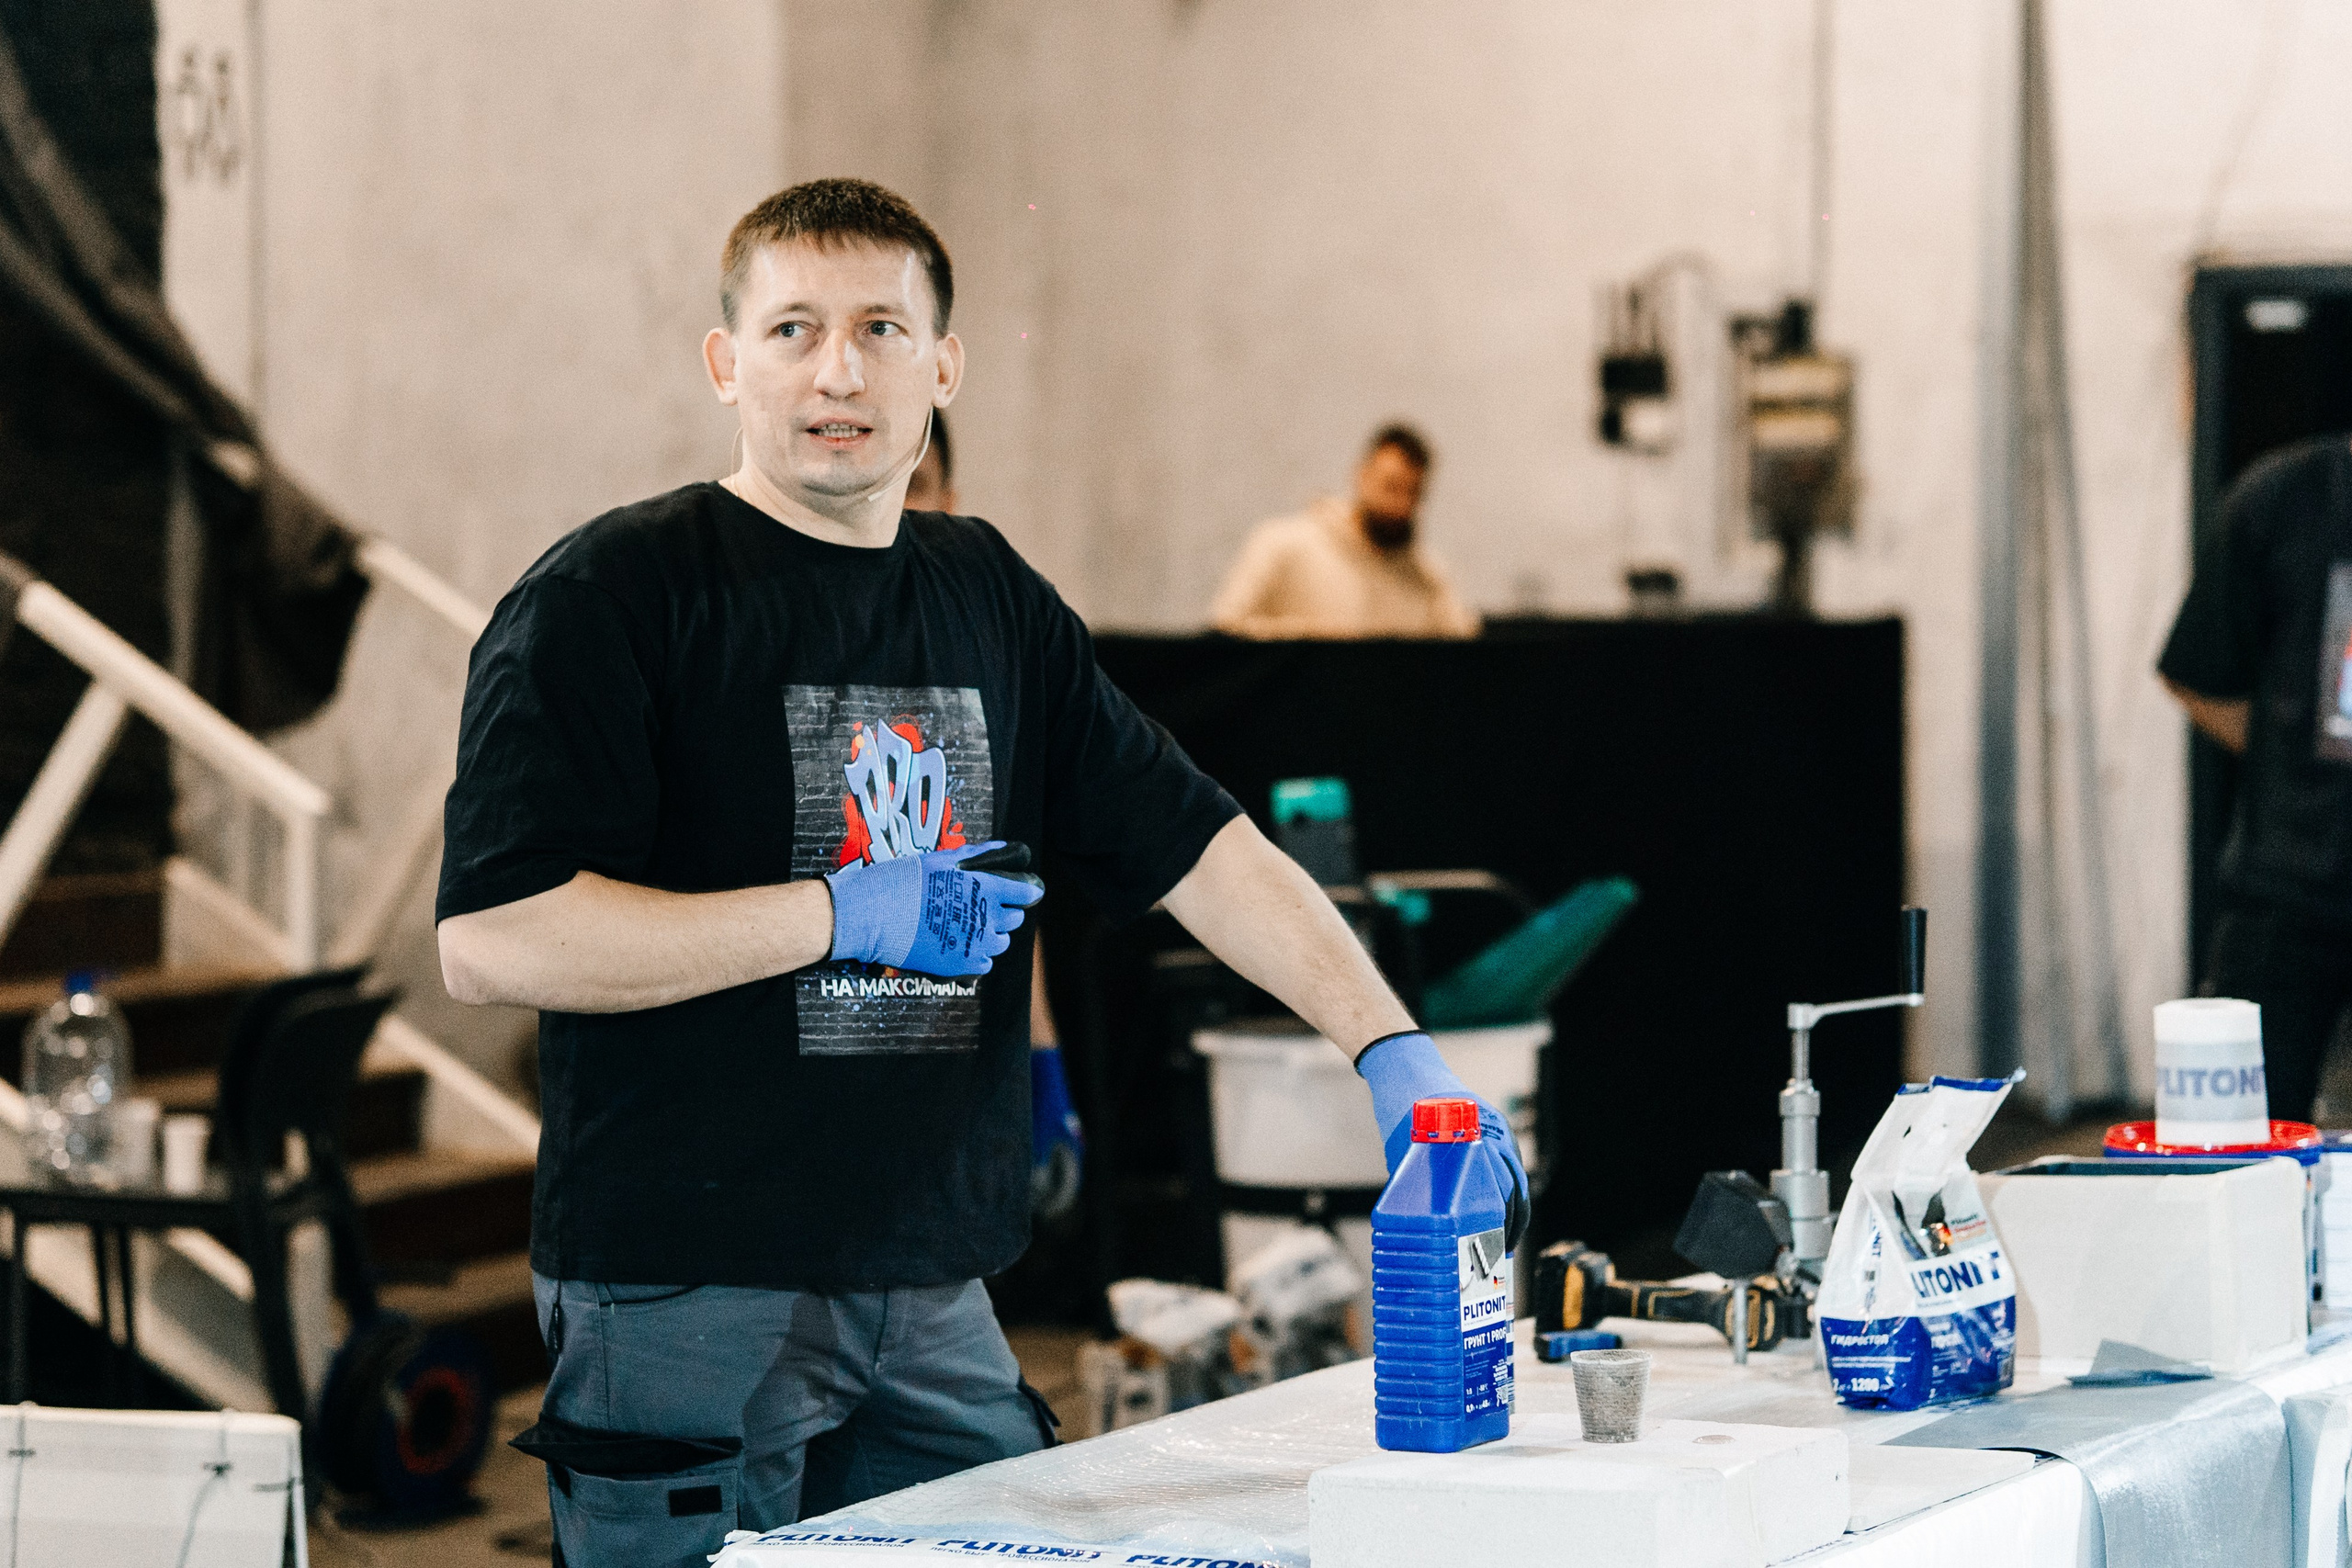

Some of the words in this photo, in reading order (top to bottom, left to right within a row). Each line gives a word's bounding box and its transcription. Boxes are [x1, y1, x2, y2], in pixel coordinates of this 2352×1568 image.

[820, 978, 854, 997] НА
[1464, 1295, 1506, 1321] PLITONIT
[1464, 1332, 1486, 1350] ГРУНТ
